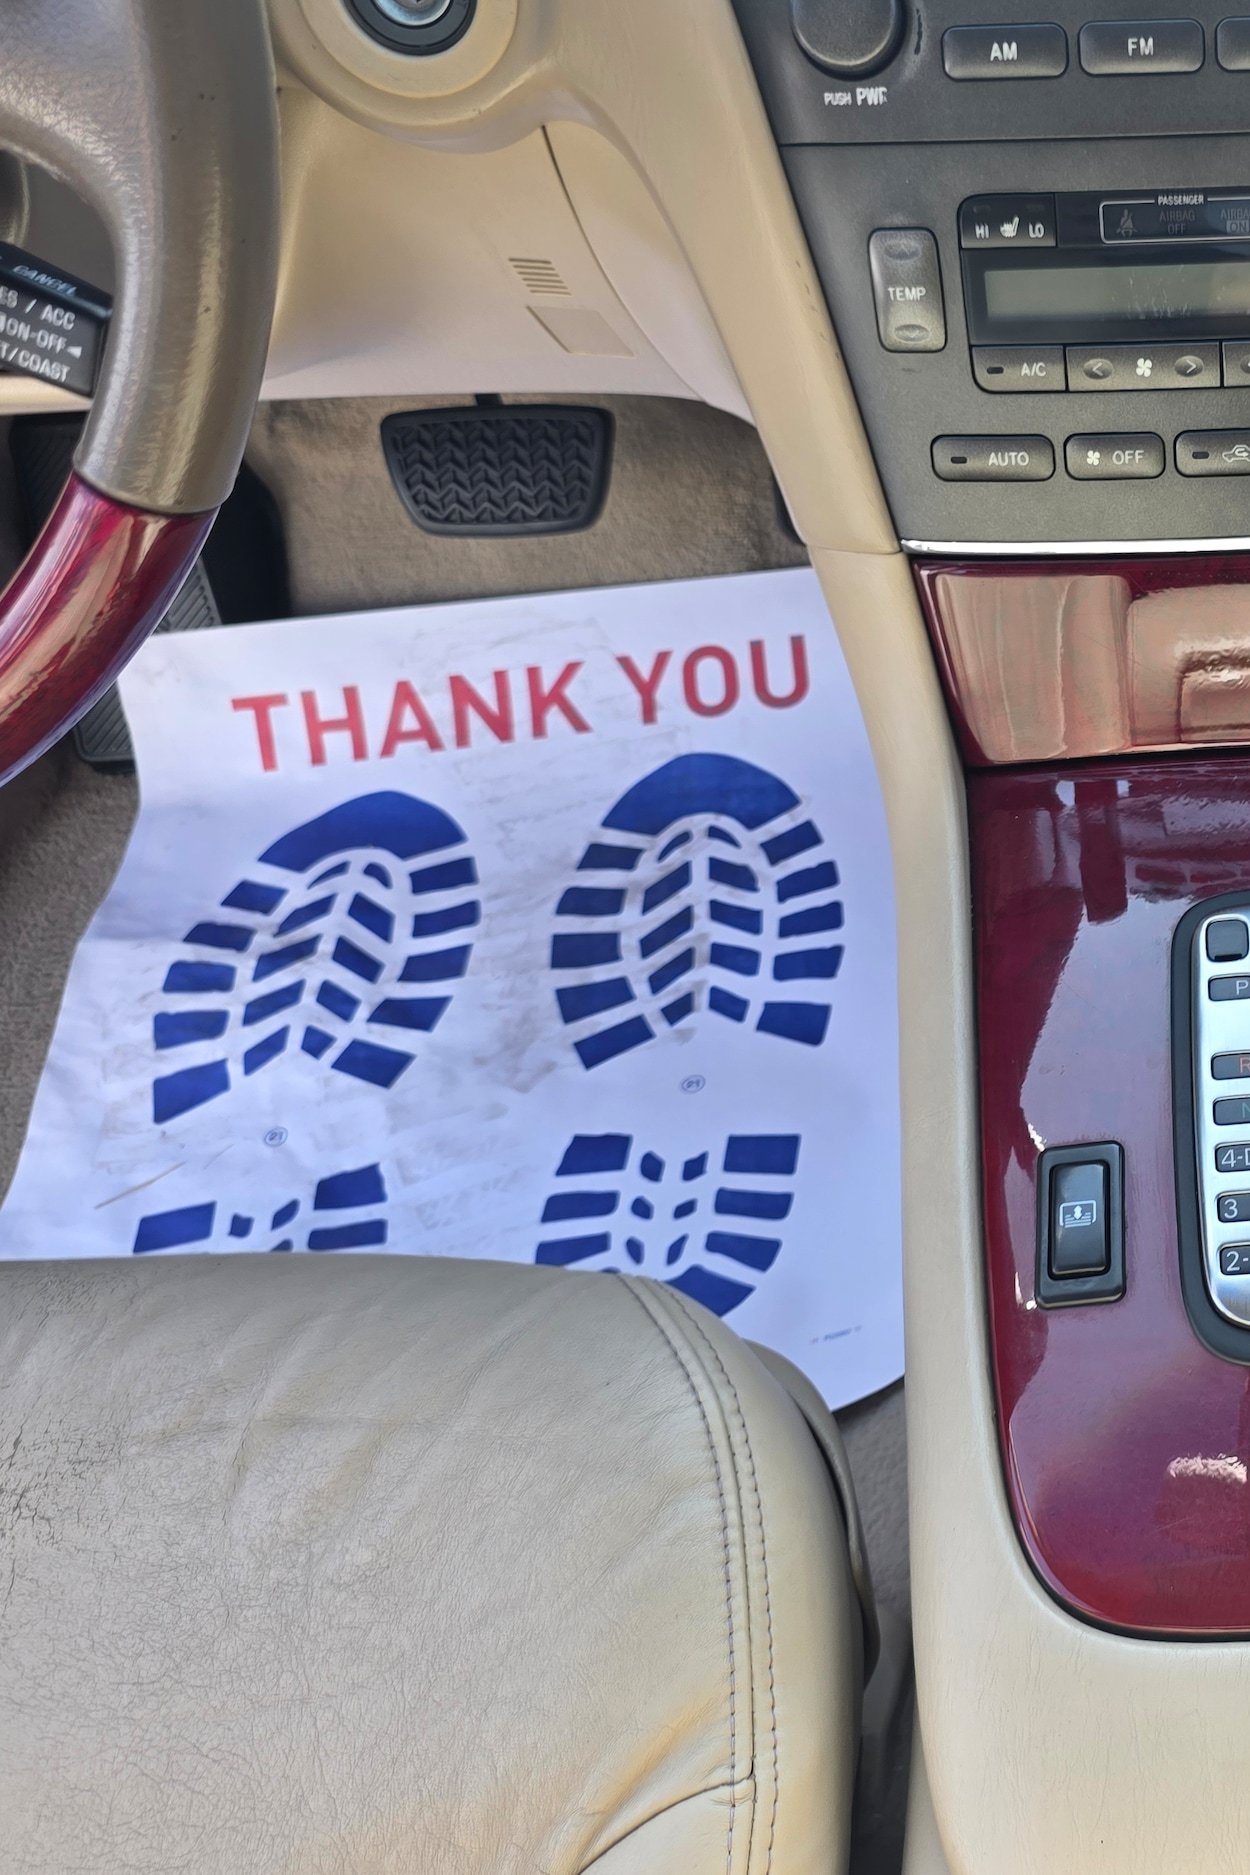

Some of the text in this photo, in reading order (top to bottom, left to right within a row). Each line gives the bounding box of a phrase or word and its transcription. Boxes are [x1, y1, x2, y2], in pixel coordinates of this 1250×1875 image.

[990, 41, 1018, 61] AM
[1127, 37, 1154, 56] FM
[824, 91, 852, 106] PUSH
[1157, 194, 1204, 205] PASSENGER
[1159, 208, 1196, 222] AIRBAG
[975, 222, 1044, 239] HI LO
[1167, 223, 1186, 234] OFF
[1228, 221, 1249, 233] ON
[887, 286, 926, 301] TEMP
[40, 304, 76, 330] ACC
[1020, 363, 1047, 377] A/C
[988, 452, 1029, 466] AUTO
[1112, 451, 1145, 464] OFF
[231, 635, 810, 772] THANK YOU
[1235, 980, 1249, 995] P
[1223, 1198, 1238, 1219] 3
